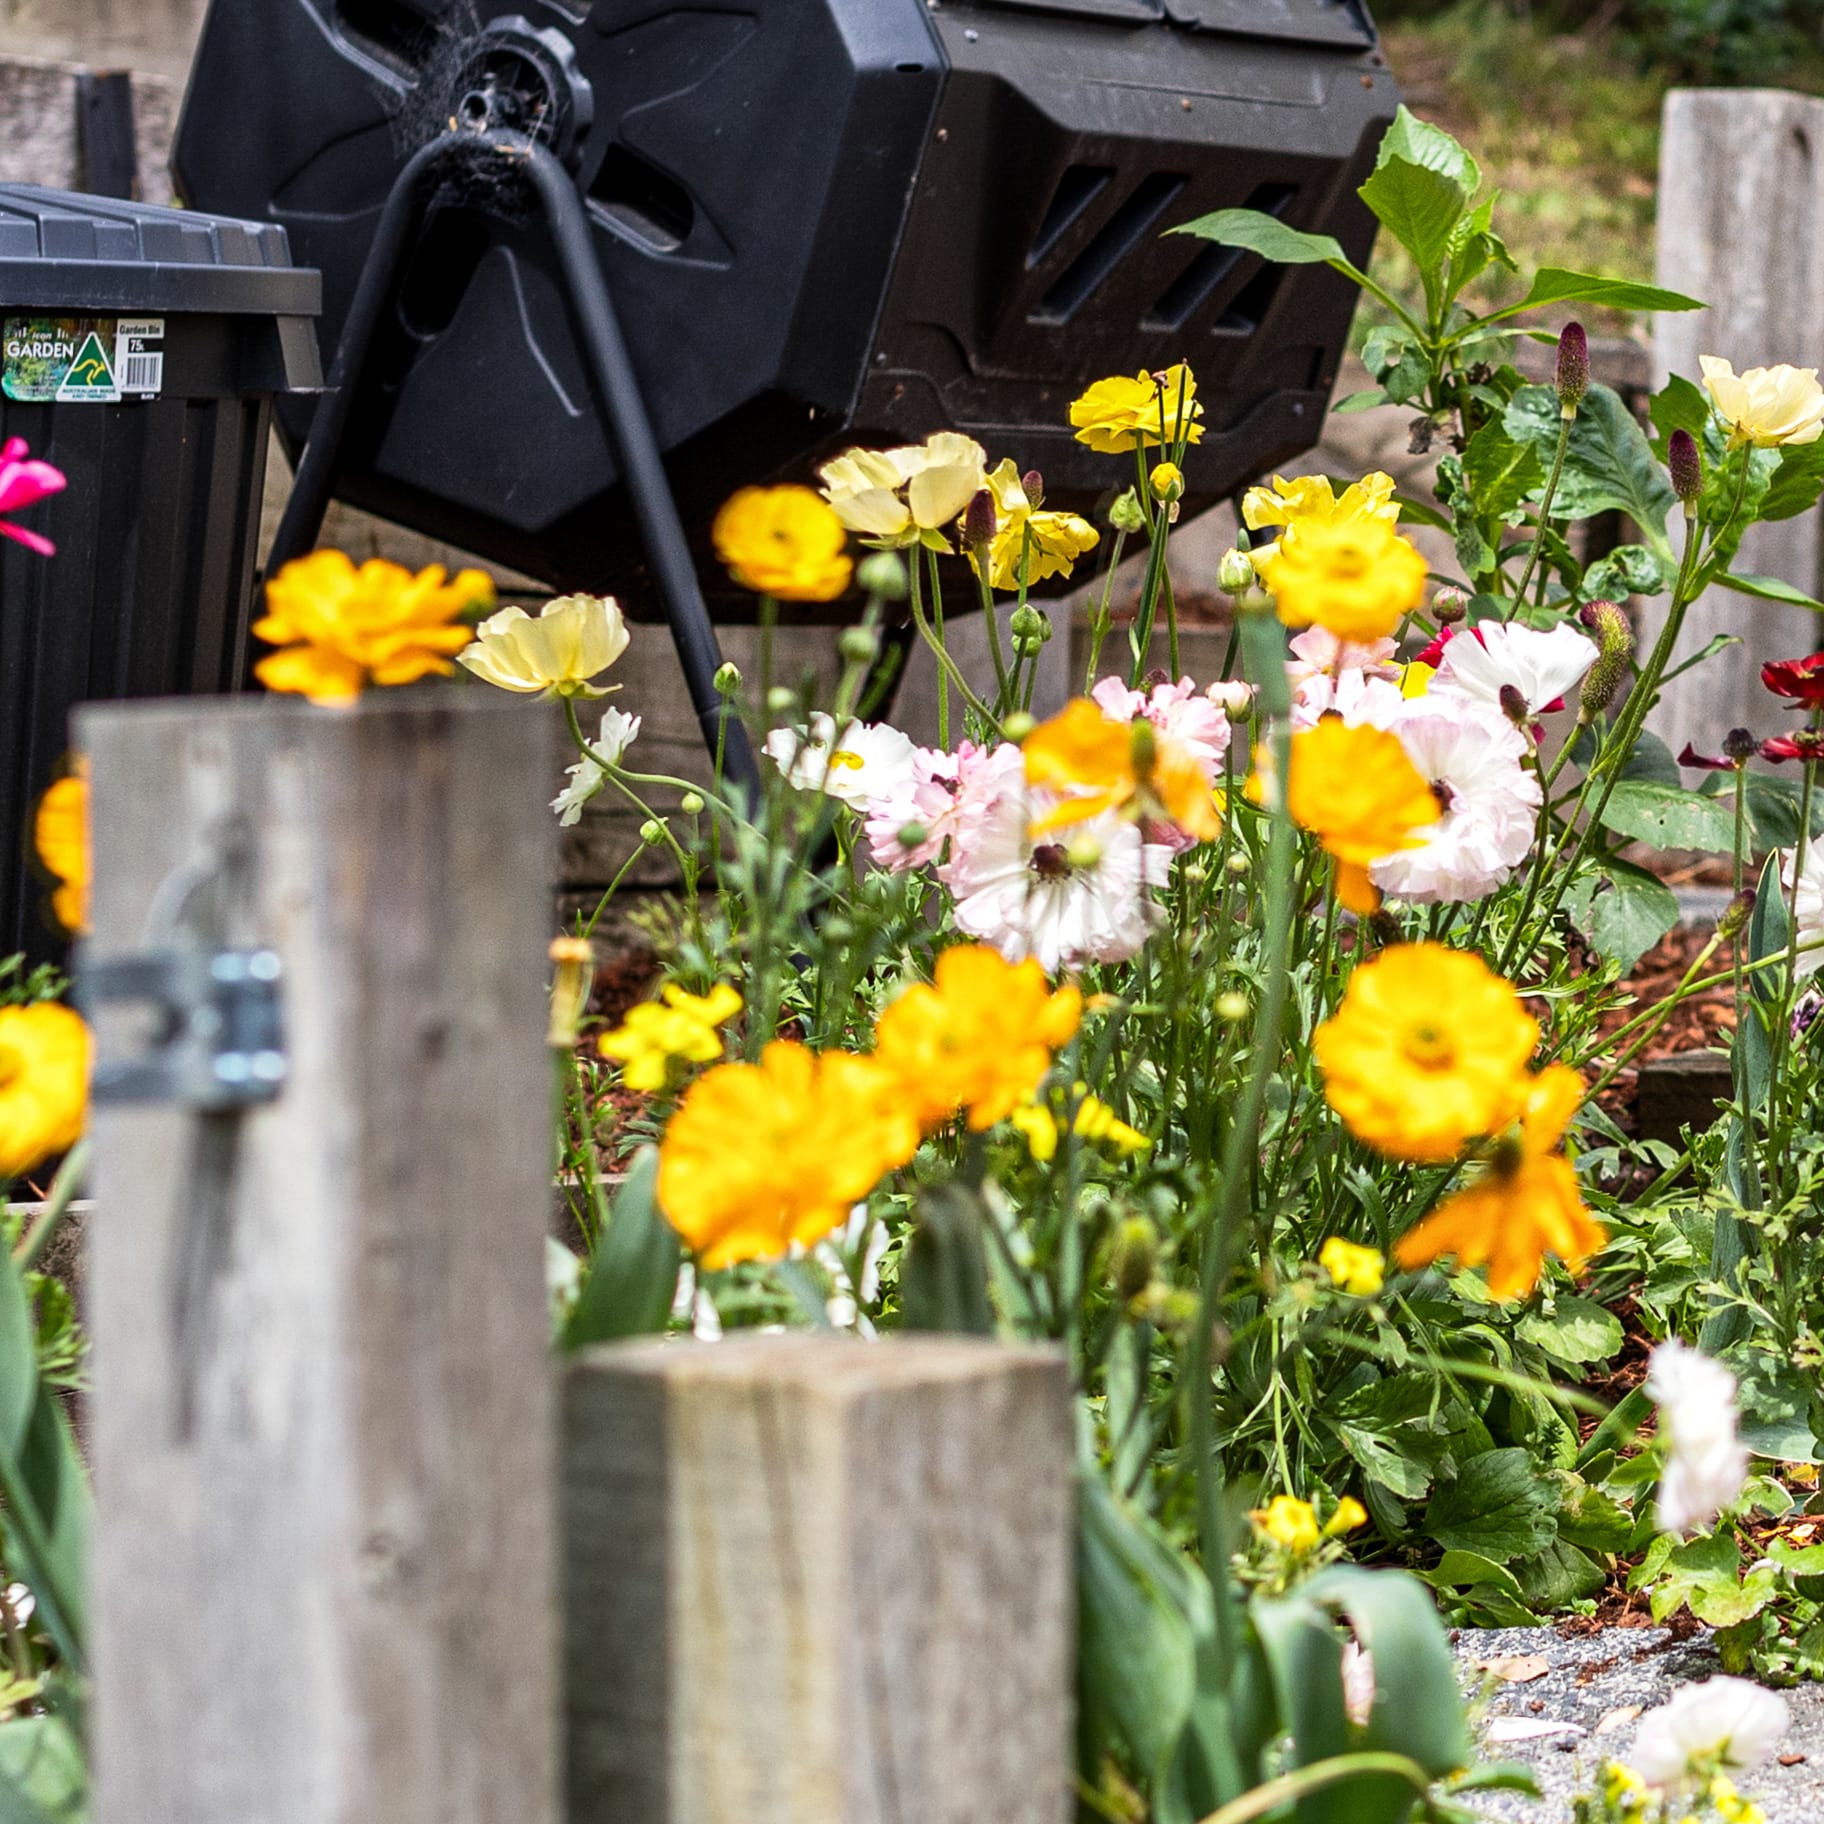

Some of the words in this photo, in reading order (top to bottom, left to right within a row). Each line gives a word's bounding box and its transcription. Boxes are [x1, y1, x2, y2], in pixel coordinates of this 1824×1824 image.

[119, 324, 147, 335] Garden
[148, 324, 160, 335] Bin
[7, 342, 74, 358] GARDEN
